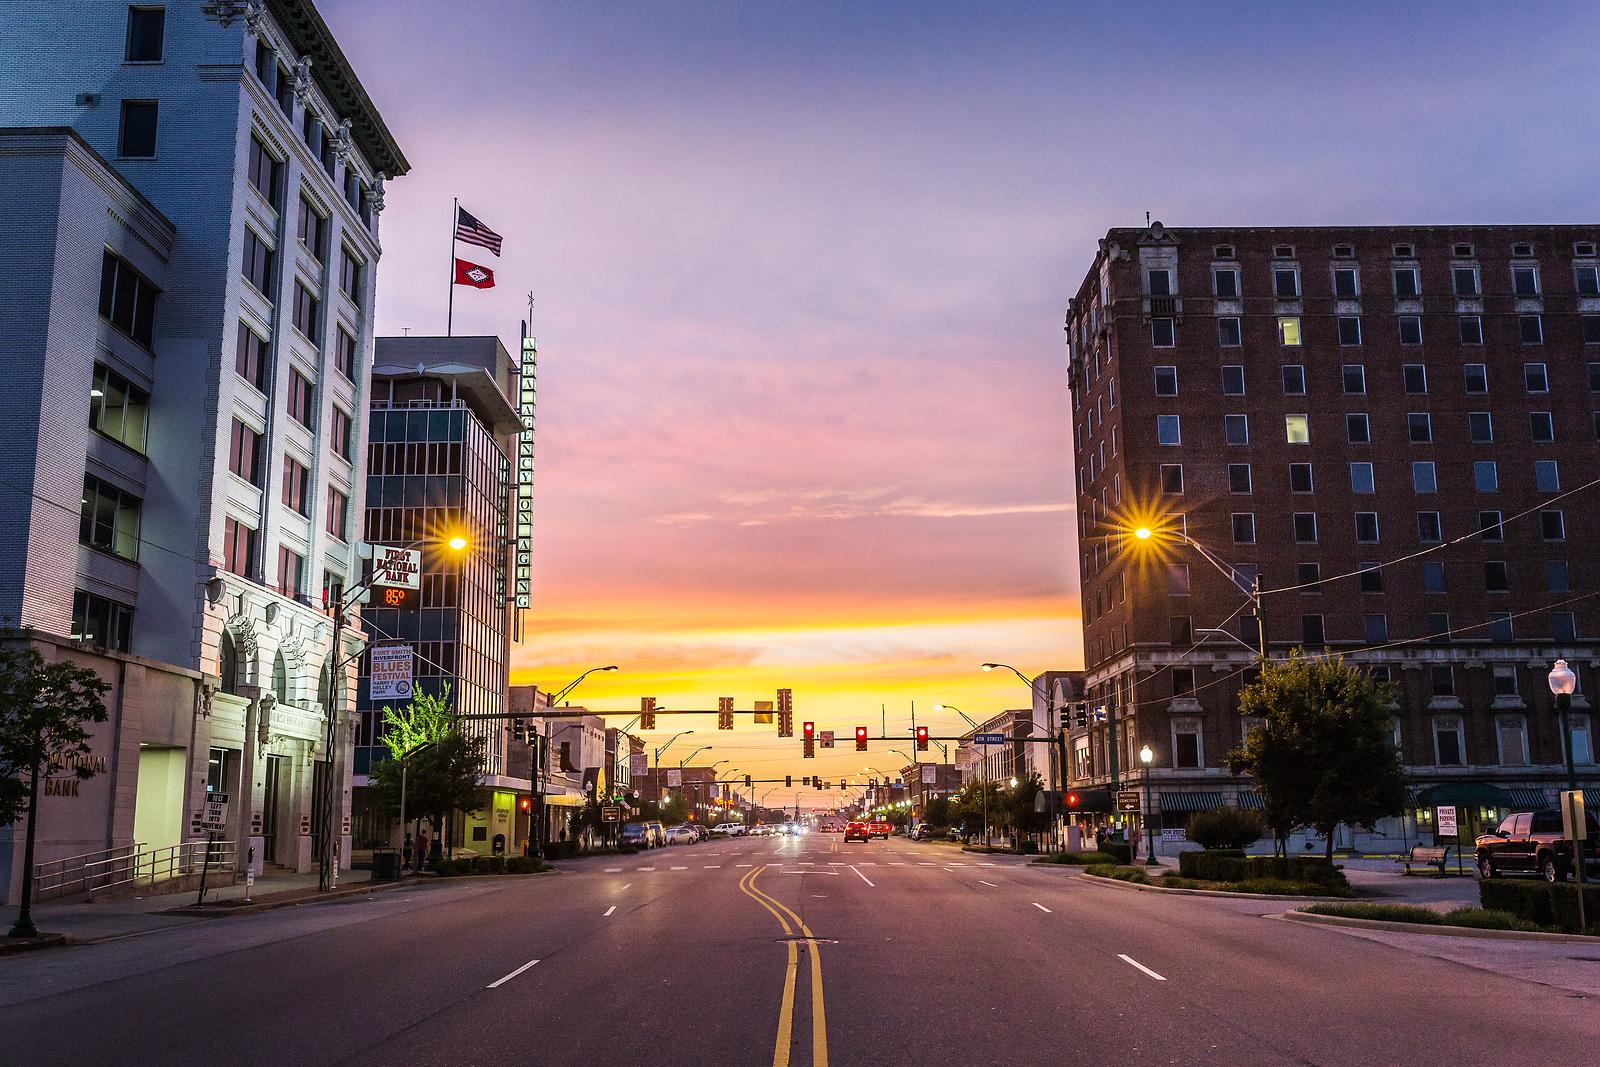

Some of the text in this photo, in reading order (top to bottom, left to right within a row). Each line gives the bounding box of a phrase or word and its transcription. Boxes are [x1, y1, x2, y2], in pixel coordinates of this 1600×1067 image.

[517, 339, 533, 606] AREA AGENCY ON AGING
[385, 549, 411, 562] FIRST
[377, 559, 418, 573] NATIONAL
[385, 571, 409, 583] BANK
[373, 662, 411, 672] BLUES
[48, 752, 107, 773] NATIONAL
[45, 778, 80, 796] BANK
[212, 794, 224, 802] NO
[201, 822, 225, 830] DRIVEWAY
